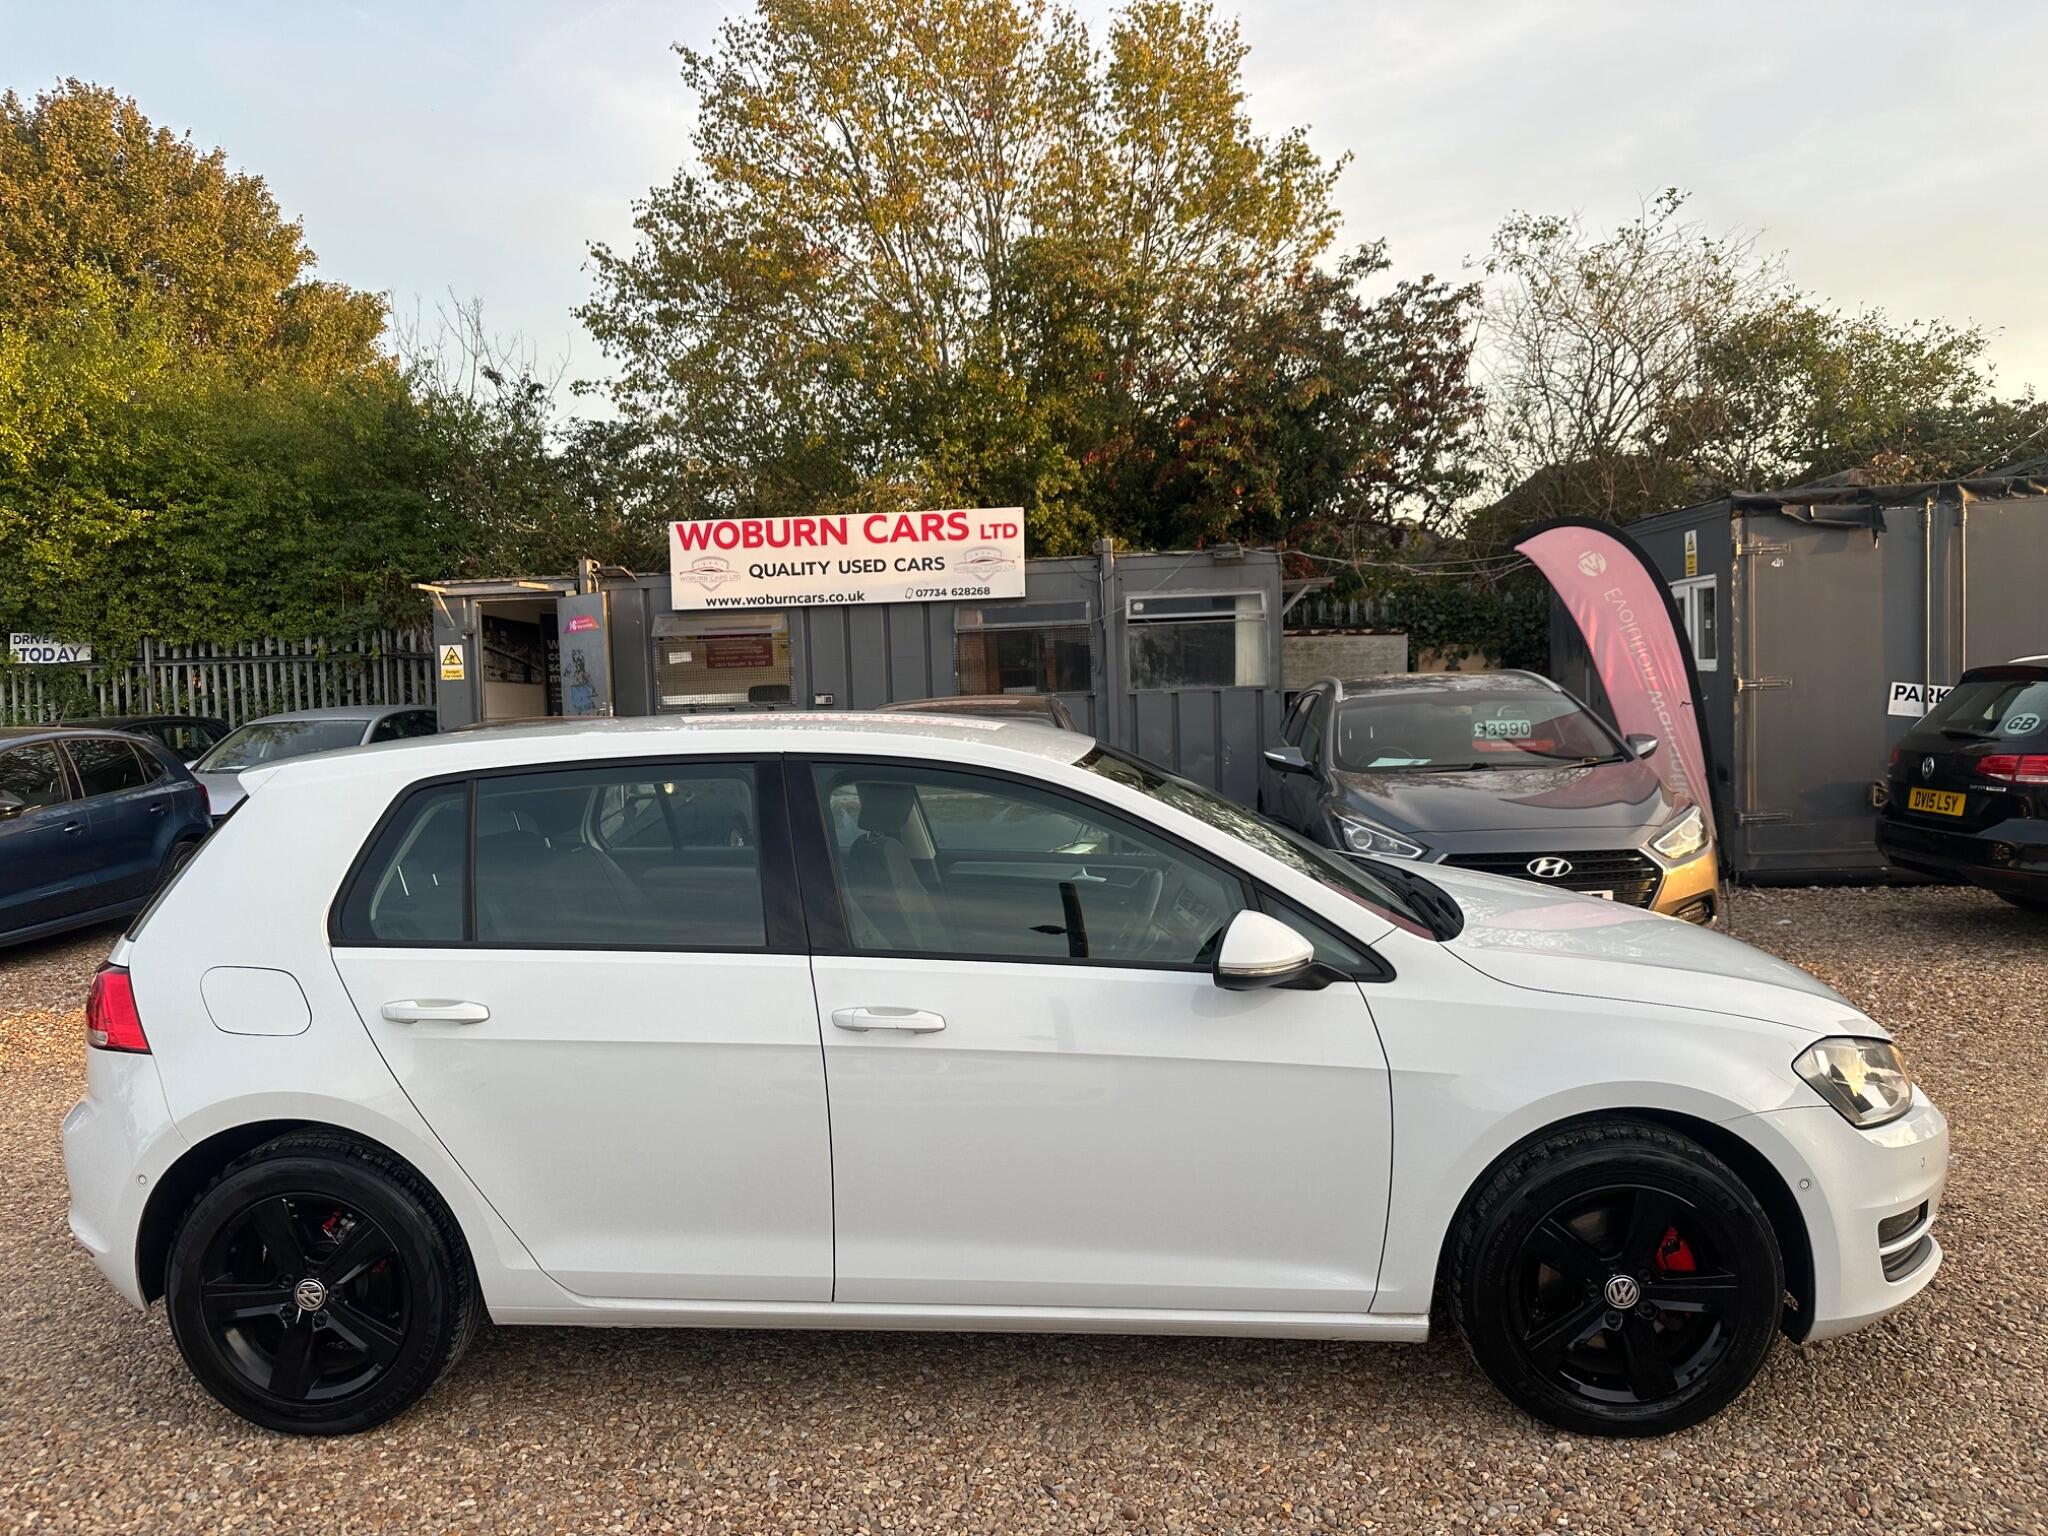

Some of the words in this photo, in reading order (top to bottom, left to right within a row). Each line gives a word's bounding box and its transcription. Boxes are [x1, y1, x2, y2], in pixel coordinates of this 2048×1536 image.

[676, 517, 848, 551] WOBURN
[863, 512, 970, 544] CARS
[980, 523, 1018, 540] LTD
[749, 561, 831, 579] QUALITY
[839, 558, 887, 574] USED
[894, 556, 946, 572] CARS
[706, 590, 865, 607] www.woburncars.co.uk
[915, 588, 947, 598] 07734
[951, 587, 991, 597] 628268
[19, 646, 82, 662] TODAY
[2007, 716, 2037, 731] GB
[1914, 791, 1937, 809] DV15
[1936, 794, 1959, 812] LSY
